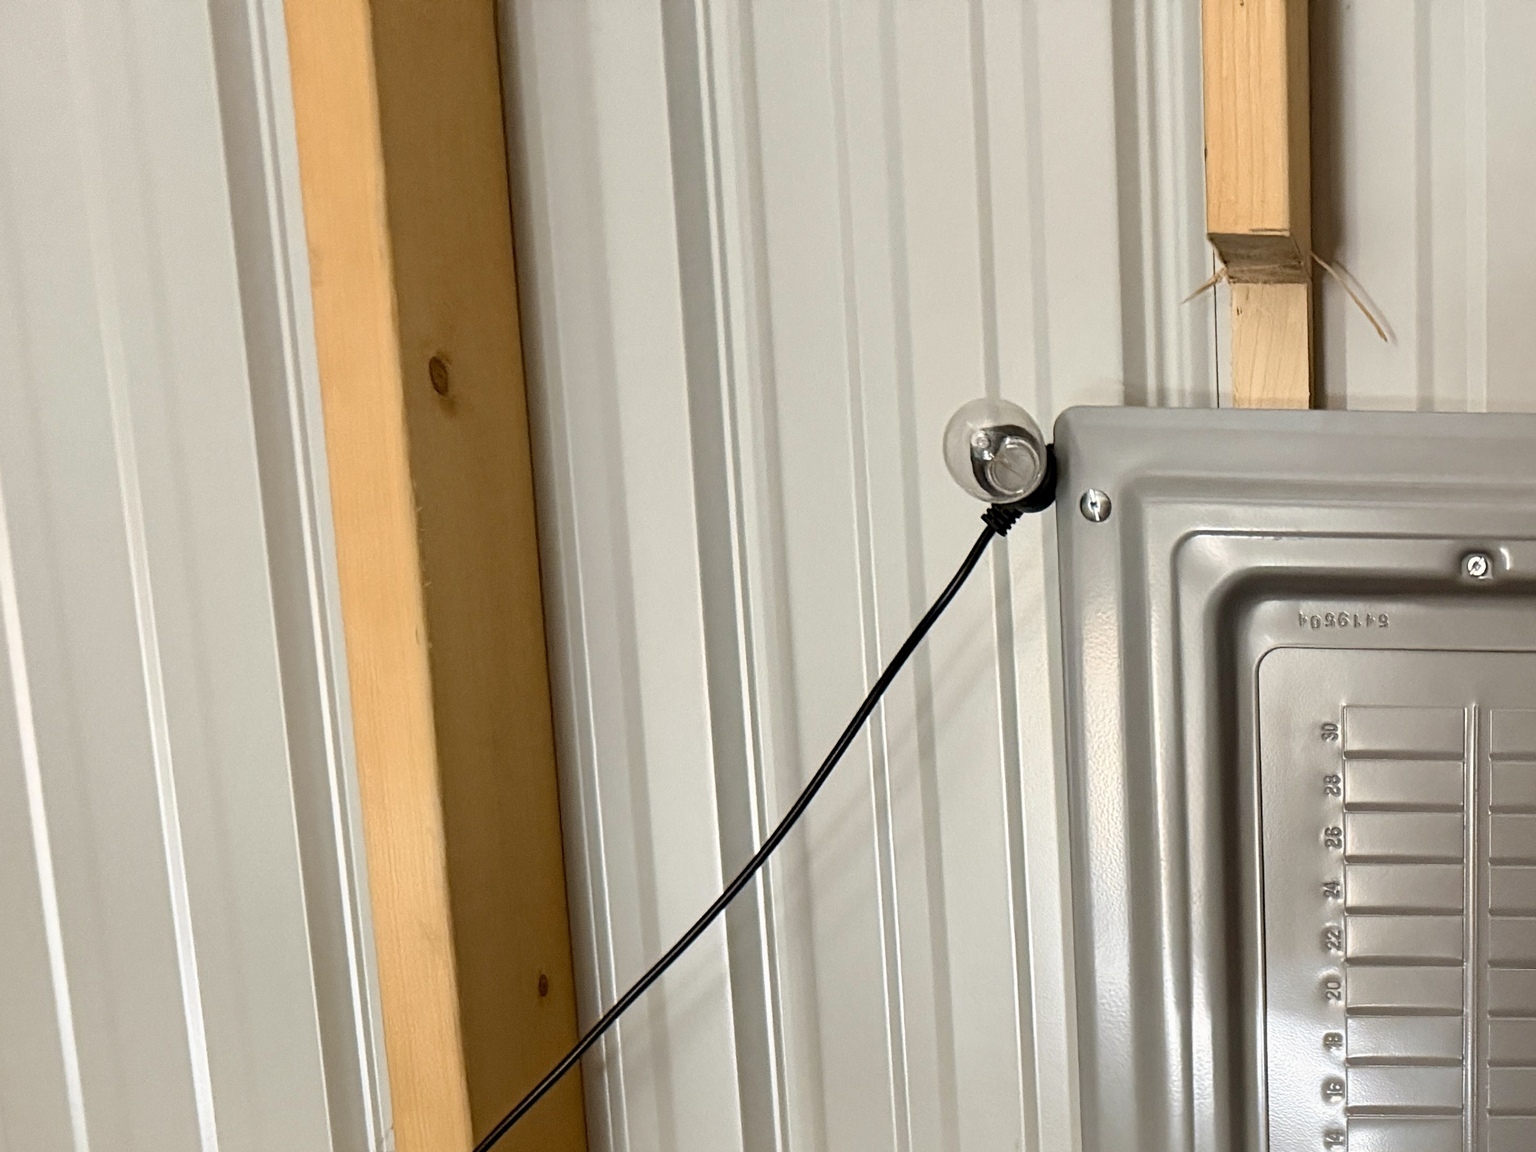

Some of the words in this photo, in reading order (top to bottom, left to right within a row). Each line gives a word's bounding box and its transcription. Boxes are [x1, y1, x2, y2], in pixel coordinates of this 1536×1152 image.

[1321, 722, 1339, 742] 30
[1324, 774, 1341, 797] 28
[1324, 826, 1343, 849] 26
[1323, 881, 1341, 900] 24
[1327, 929, 1342, 951] 22
[1325, 980, 1342, 1001] 20
